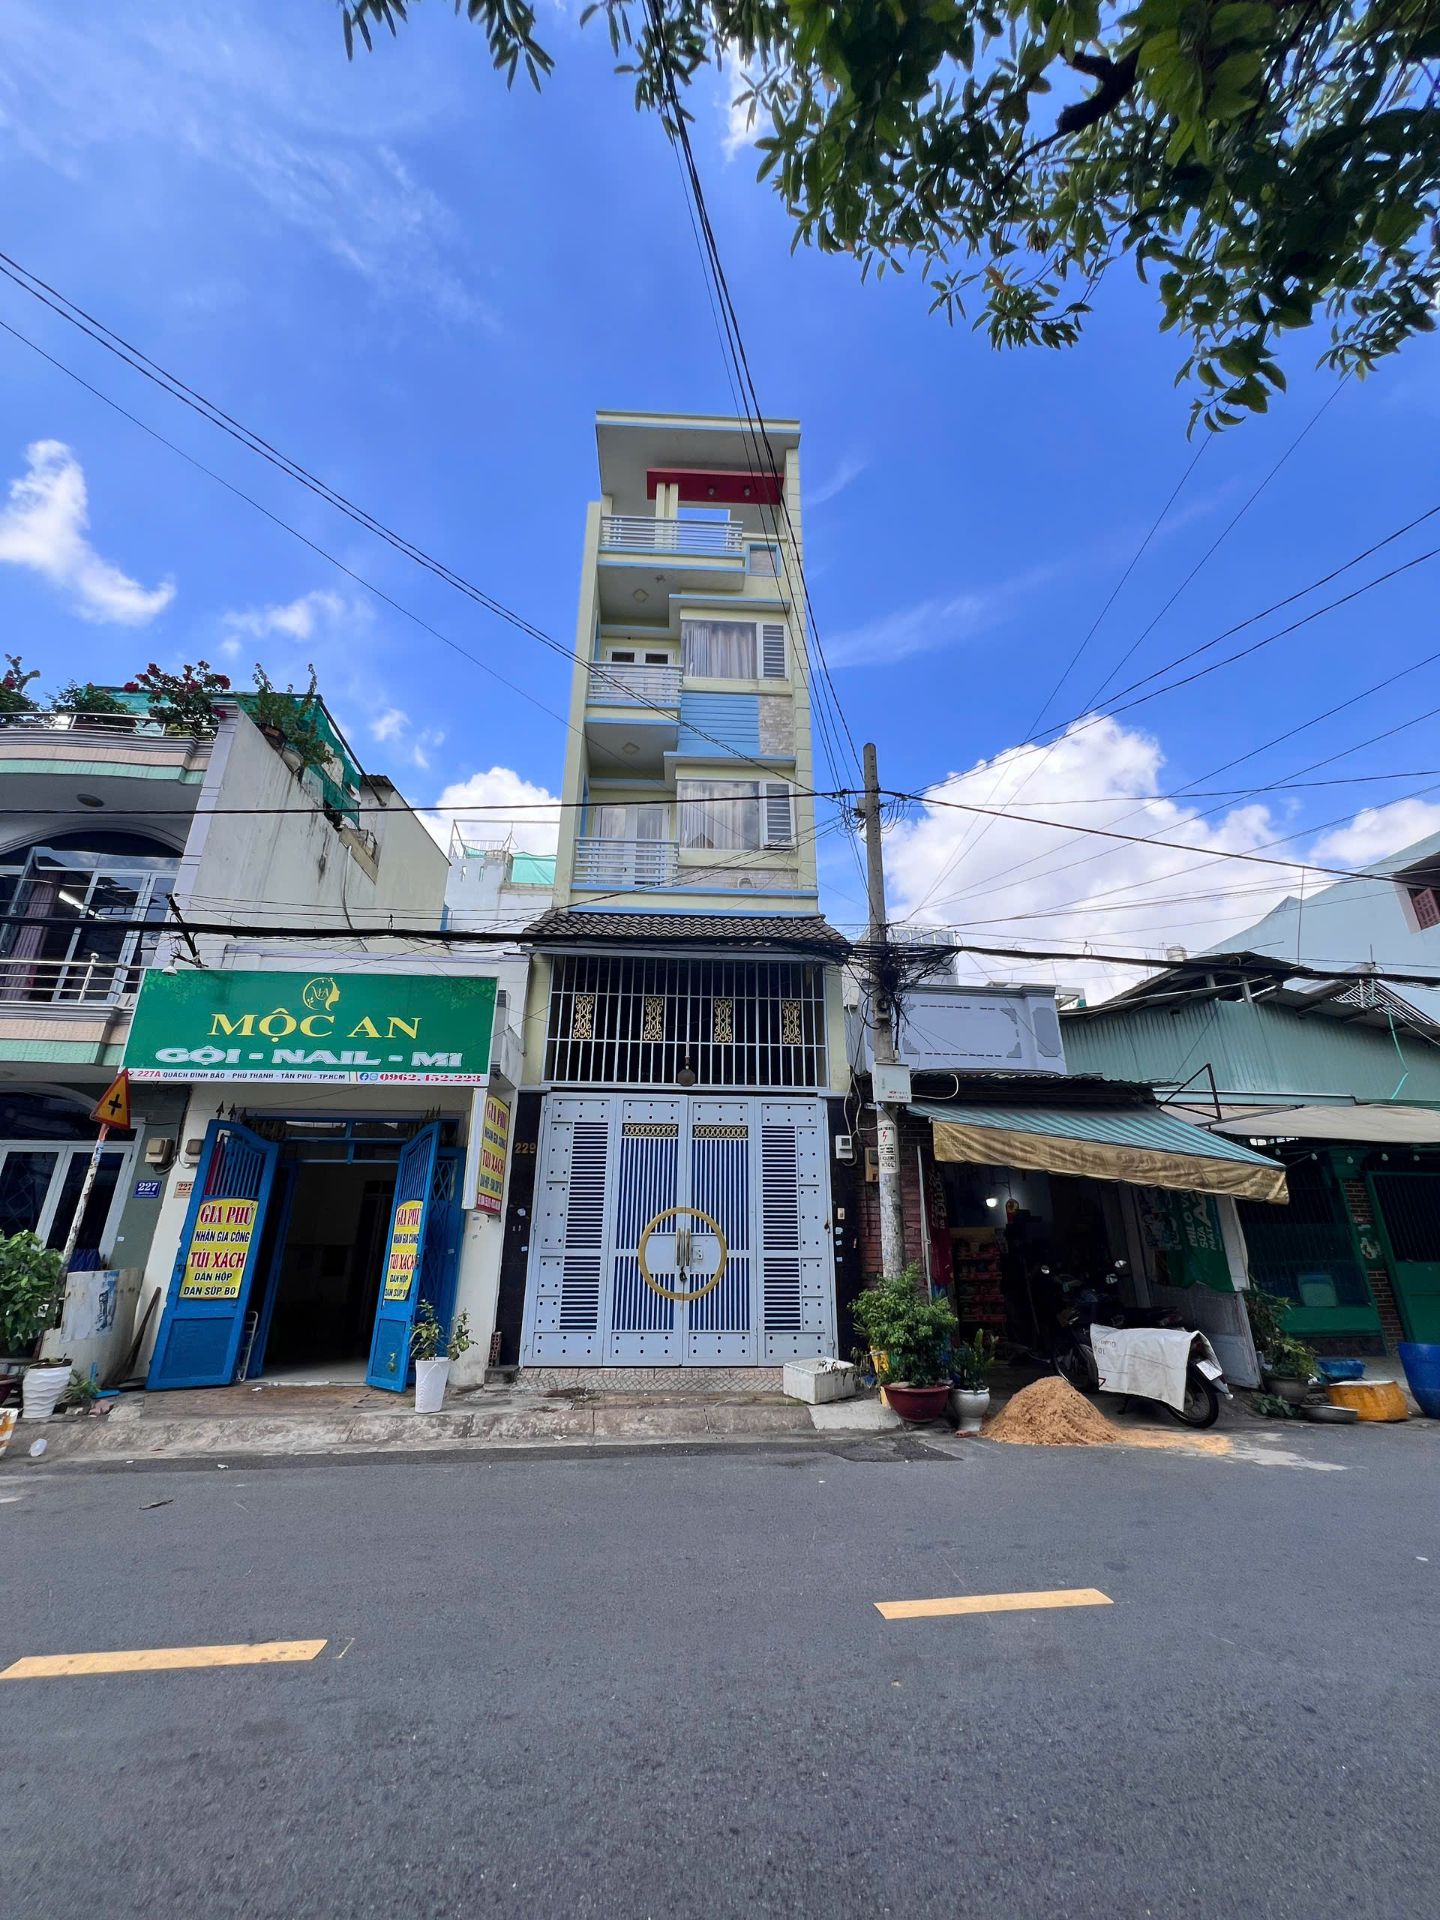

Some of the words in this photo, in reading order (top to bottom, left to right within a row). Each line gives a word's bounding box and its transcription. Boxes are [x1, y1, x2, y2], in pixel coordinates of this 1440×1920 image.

[207, 1007, 335, 1043] MỘC
[346, 1016, 422, 1040] AN
[271, 1049, 382, 1066] NAIL
[137, 1070, 161, 1079] 227A
[514, 1143, 537, 1154] 229
[137, 1182, 158, 1192] 227
[200, 1204, 222, 1225] GIA
[216, 1231, 229, 1242] GIA
[230, 1229, 250, 1243] CÔNG
[1183, 1211, 1198, 1248] MILO
[190, 1248, 211, 1268] TÚI
[211, 1248, 246, 1268] XÁCH
[214, 1270, 233, 1282] HỘP
